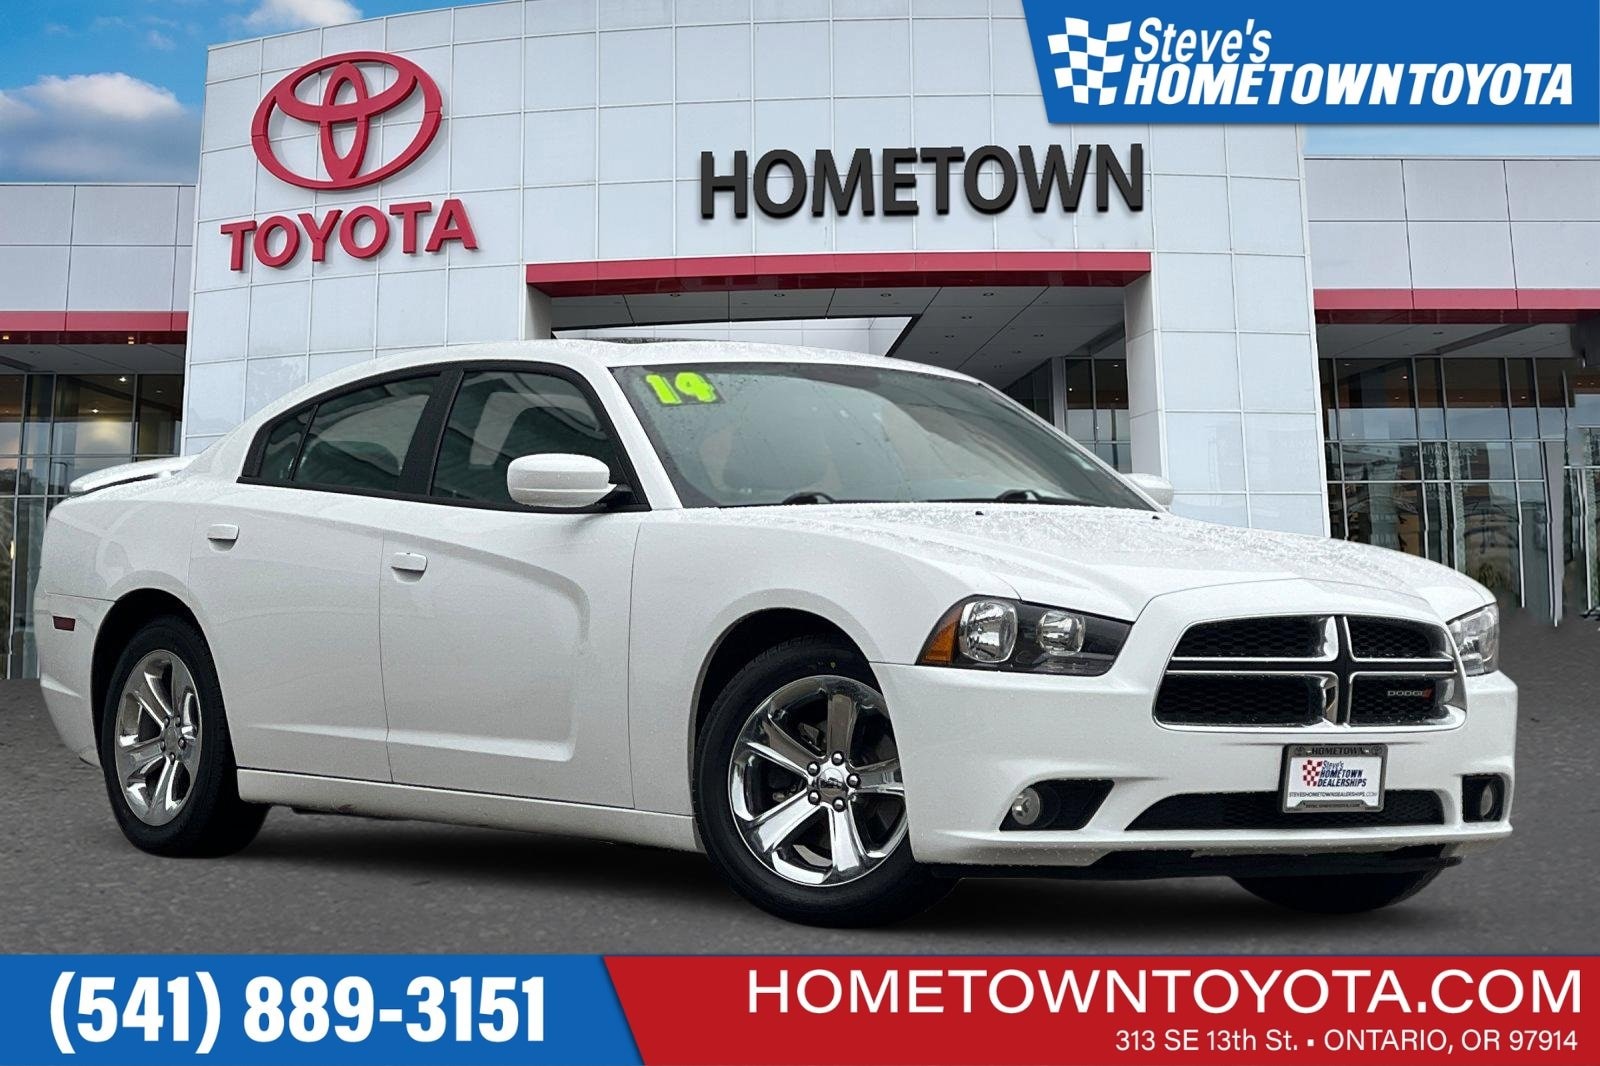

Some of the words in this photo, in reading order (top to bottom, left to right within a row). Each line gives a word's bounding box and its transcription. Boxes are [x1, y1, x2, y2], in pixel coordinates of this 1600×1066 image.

[700, 143, 1145, 219] HOMETOWN
[221, 199, 478, 271] TOYOTA
[645, 371, 717, 405] 14
[1311, 746, 1366, 756] HOMETOWN
[1322, 760, 1344, 769] Steve's
[1320, 769, 1363, 778] HOMETOWN
[1317, 778, 1367, 787] DEALERSHIPS
